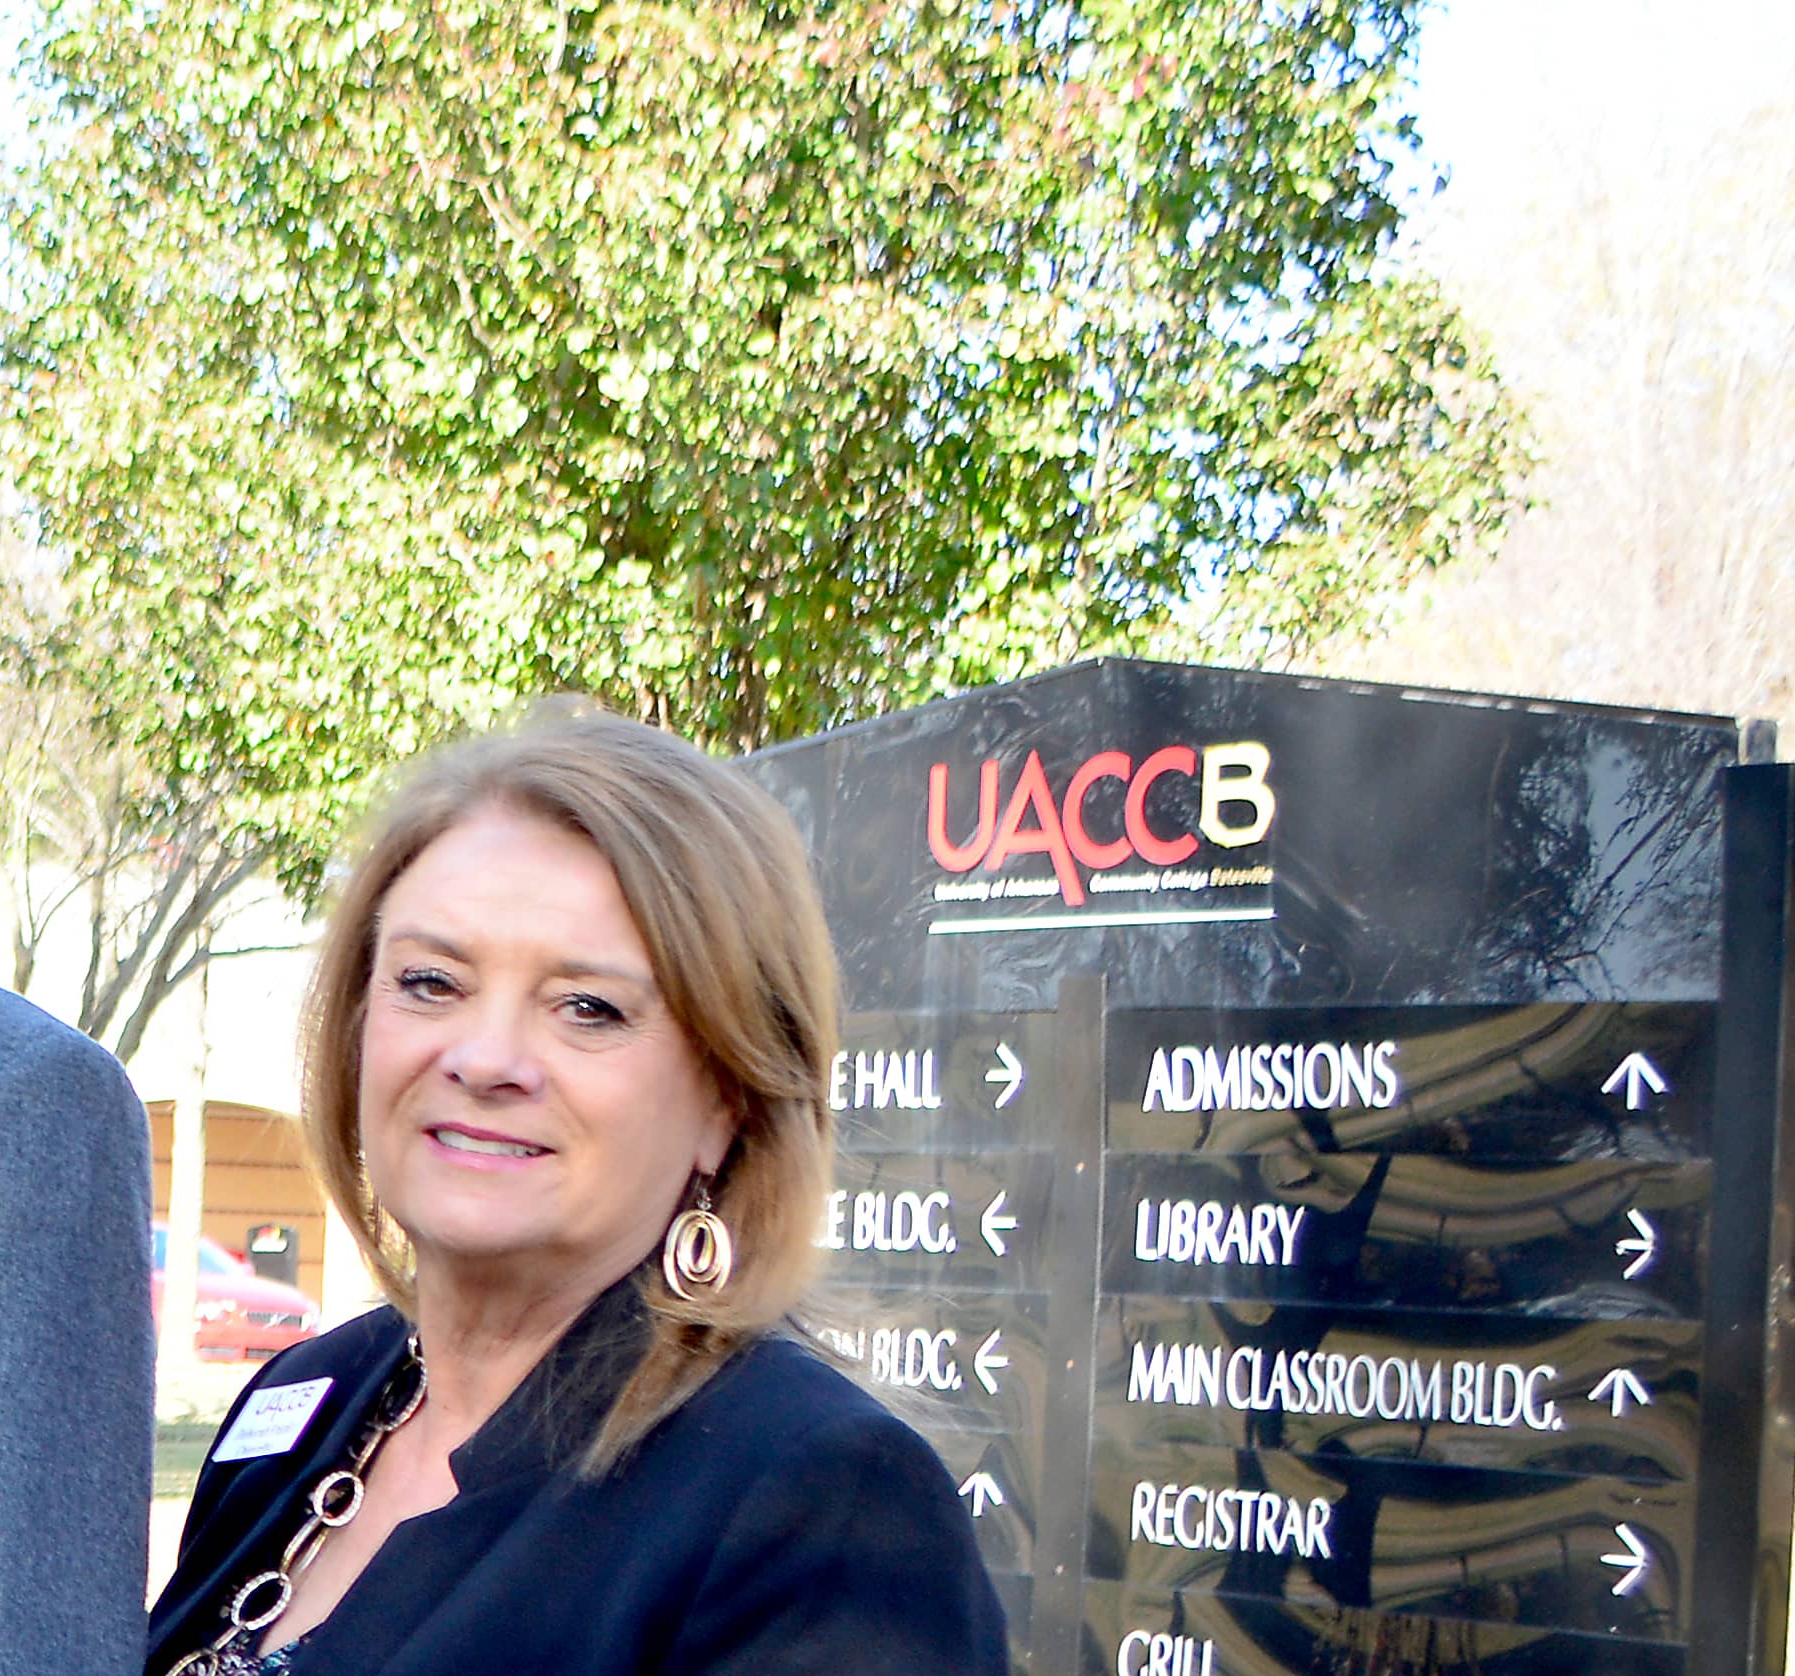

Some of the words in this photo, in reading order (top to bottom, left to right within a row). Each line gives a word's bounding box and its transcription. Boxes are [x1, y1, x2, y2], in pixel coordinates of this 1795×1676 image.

[928, 741, 1275, 906] UACCB
[854, 1048, 943, 1110] HALL
[1142, 1040, 1398, 1113] ADMISSIONS
[852, 1190, 958, 1254] BLDG.
[1135, 1197, 1306, 1267] LIBRARY
[871, 1327, 962, 1391] BLDG.
[1127, 1340, 1221, 1407] MAIN
[1225, 1344, 1442, 1421] CLASSROOM
[1449, 1359, 1564, 1432] BLDG.
[1130, 1480, 1332, 1560] REGISTRAR
